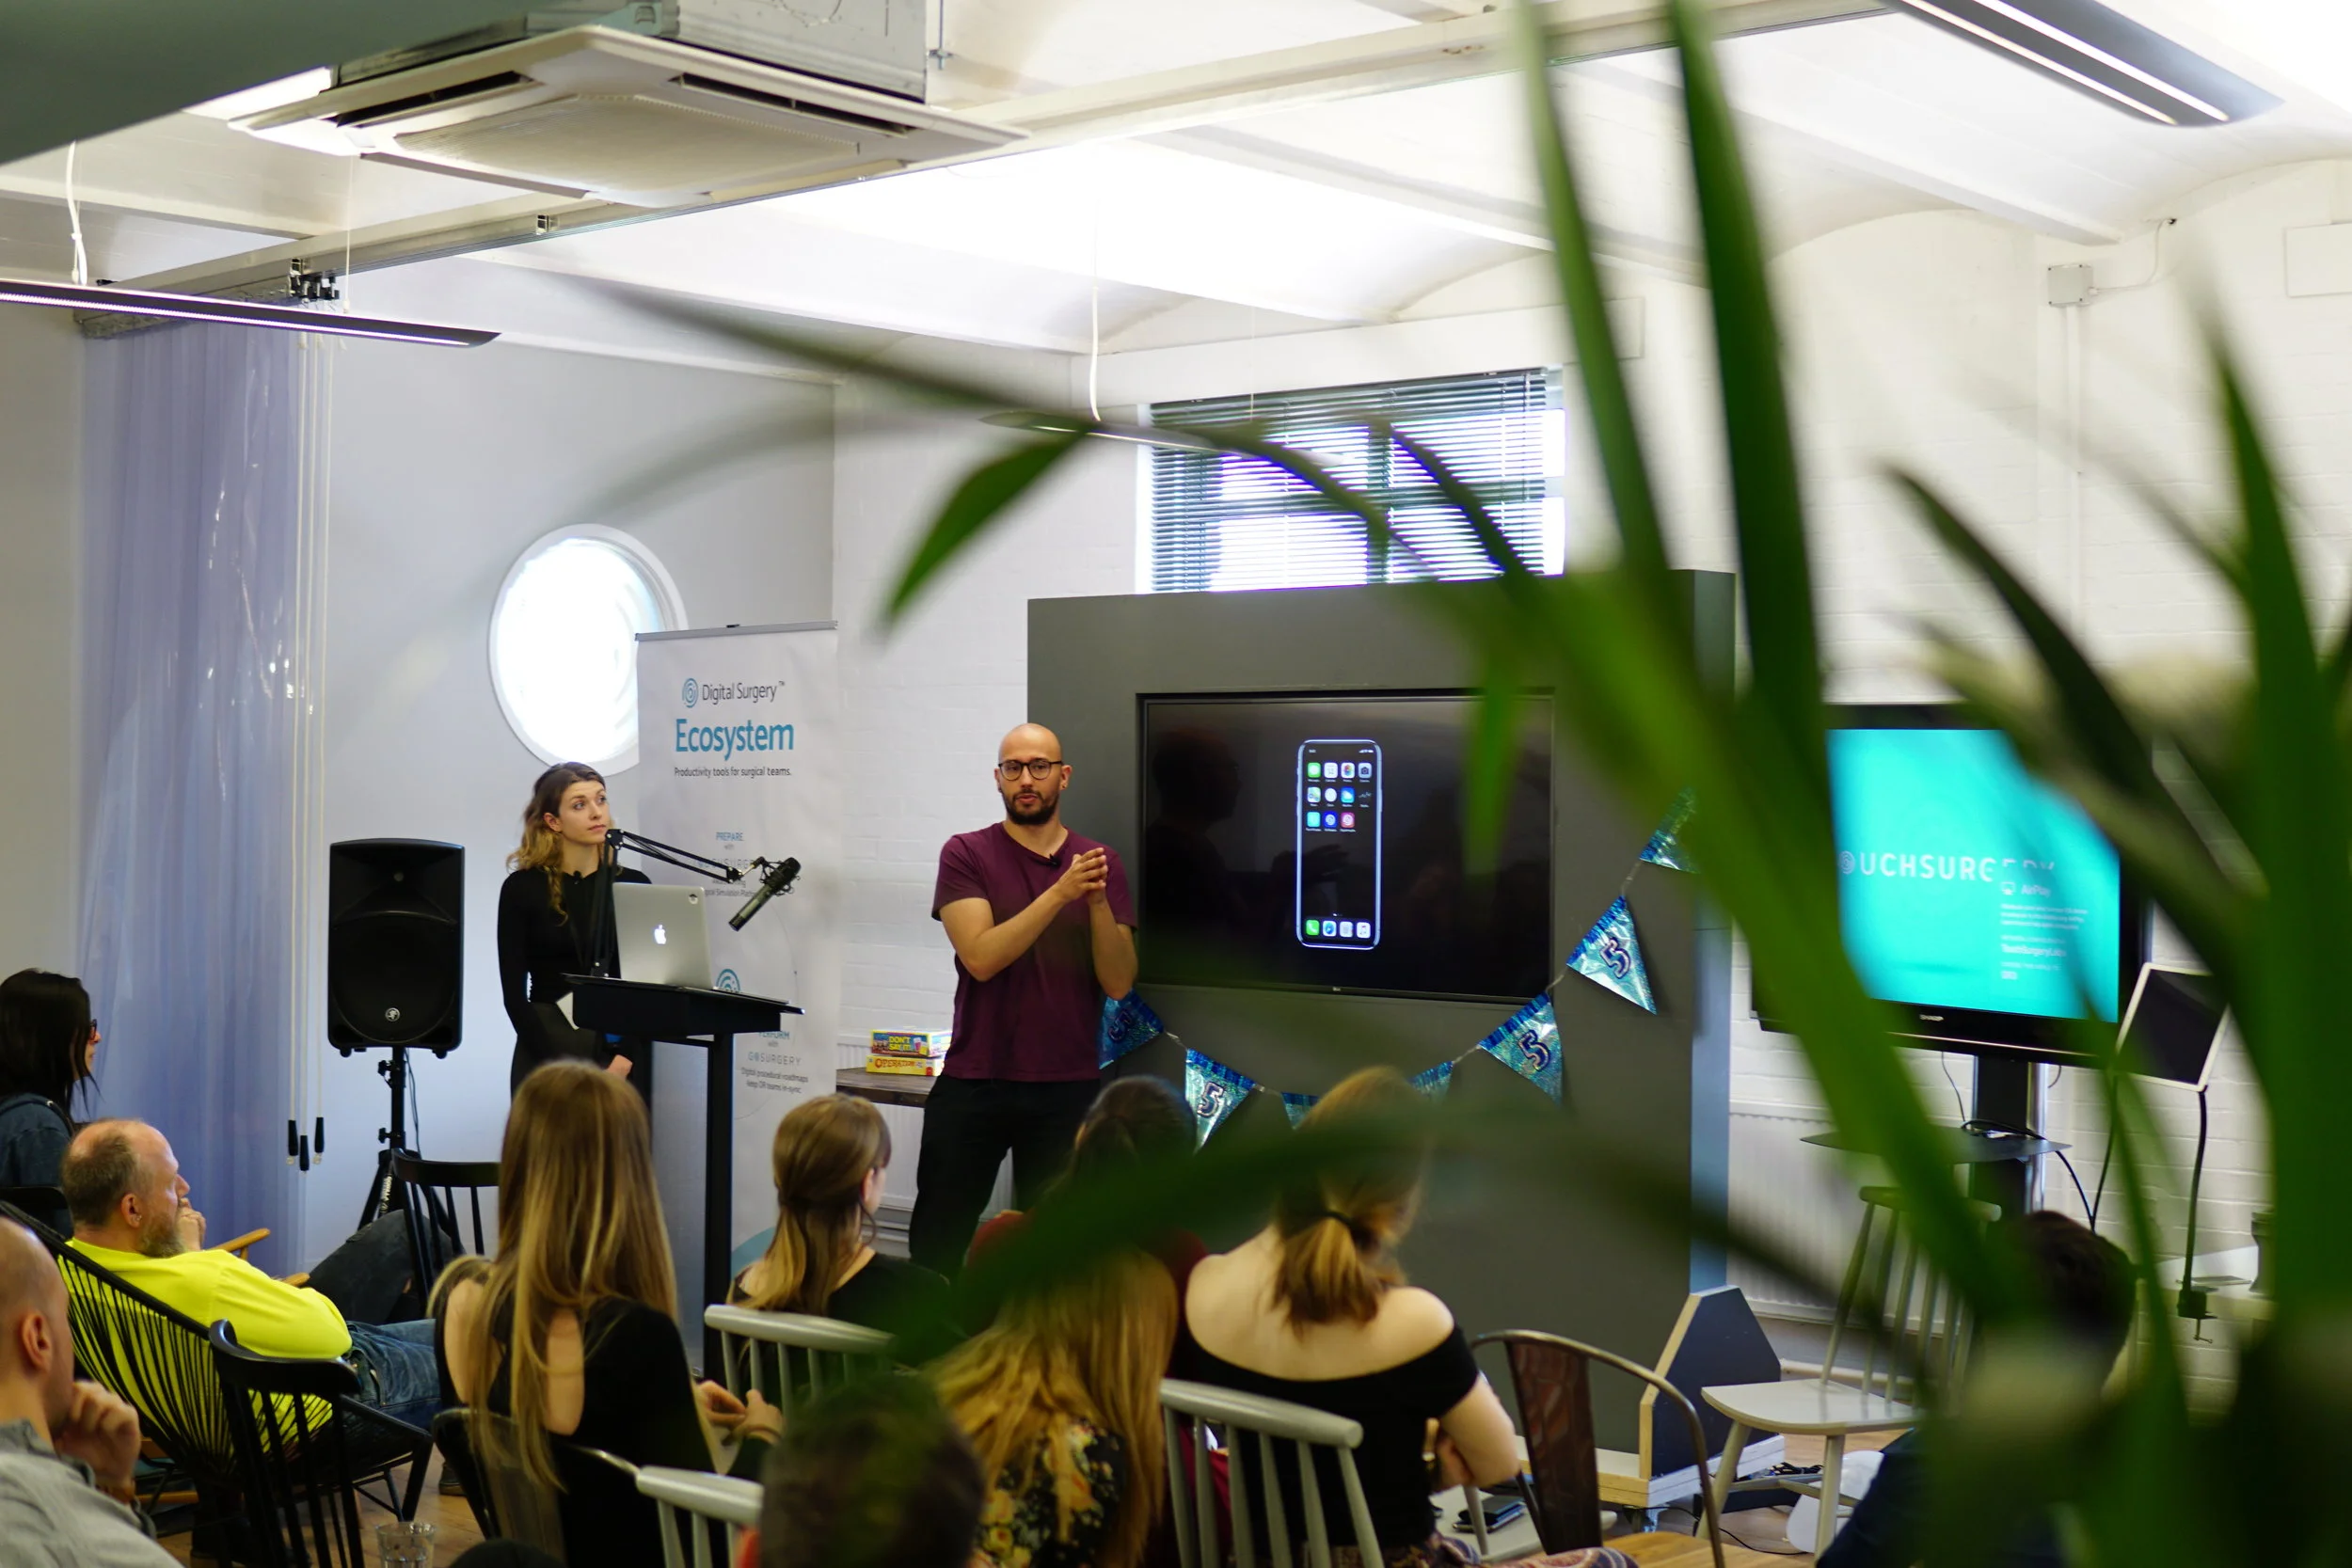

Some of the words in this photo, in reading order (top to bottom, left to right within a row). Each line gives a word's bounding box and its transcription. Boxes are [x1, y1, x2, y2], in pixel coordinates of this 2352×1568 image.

[702, 683, 734, 705] Digital
[675, 718, 794, 761] Ecosystem
[674, 767, 710, 778] Productivity
[713, 767, 729, 776] tools
[730, 766, 739, 776] for
[740, 766, 765, 779] surgical
[716, 832, 744, 841] PREPARE
[1599, 937, 1631, 979] 5
[1107, 1009, 1131, 1041] 5
[1518, 1029, 1551, 1071] 5
[1196, 1081, 1224, 1117] 5
